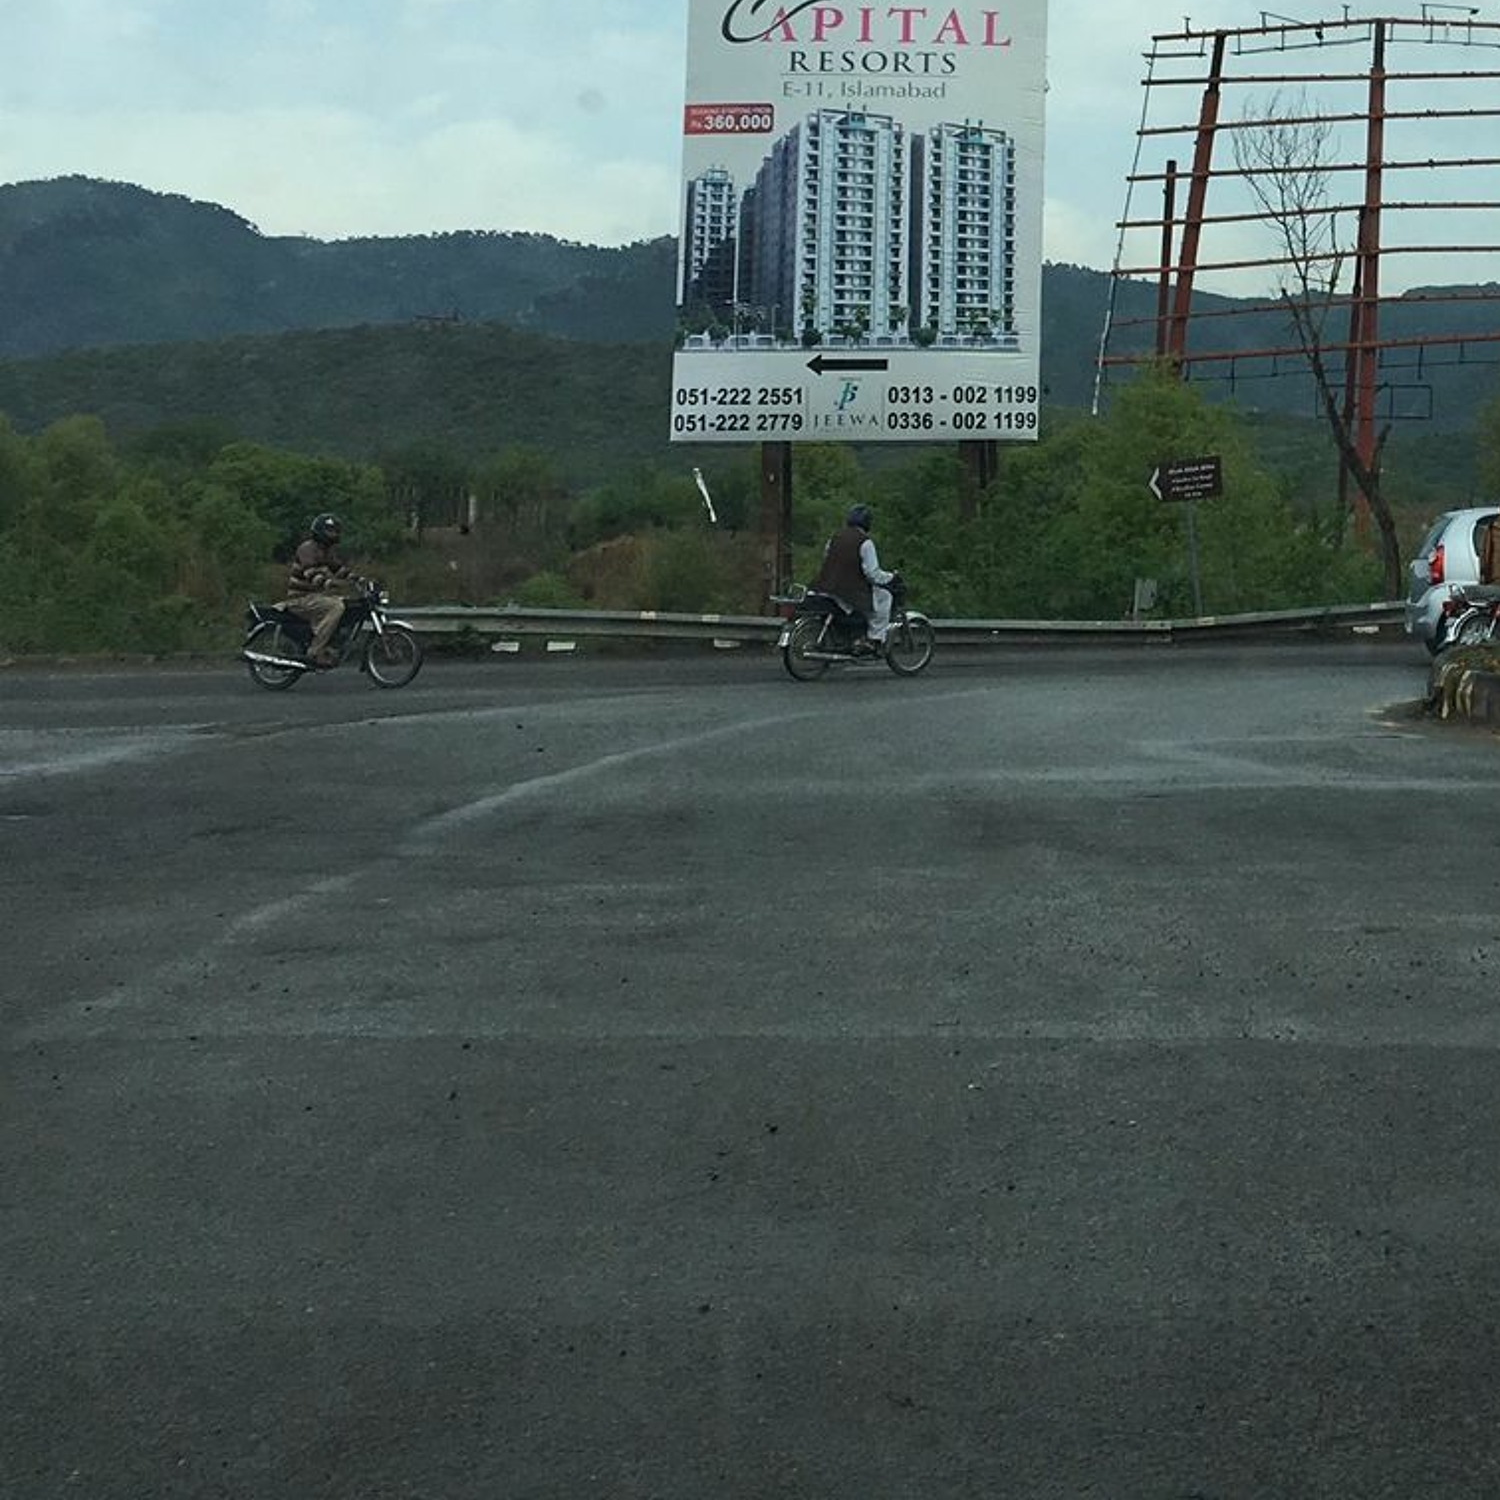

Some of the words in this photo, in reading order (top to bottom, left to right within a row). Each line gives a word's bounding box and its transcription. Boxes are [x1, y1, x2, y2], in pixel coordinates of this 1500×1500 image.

[789, 50, 957, 74] RESORTS
[782, 80, 833, 99] E-11,
[840, 80, 946, 100] Islamabad
[703, 114, 771, 131] 360,000
[676, 387, 751, 406] 051-222
[757, 387, 802, 406] 2551
[888, 386, 934, 404] 0313
[953, 386, 987, 404] 002
[994, 386, 1037, 404] 1199
[674, 414, 751, 432] 051-222
[756, 414, 803, 432] 2779
[887, 412, 934, 430] 0336
[952, 412, 987, 430] 002
[994, 412, 1037, 430] 1199
